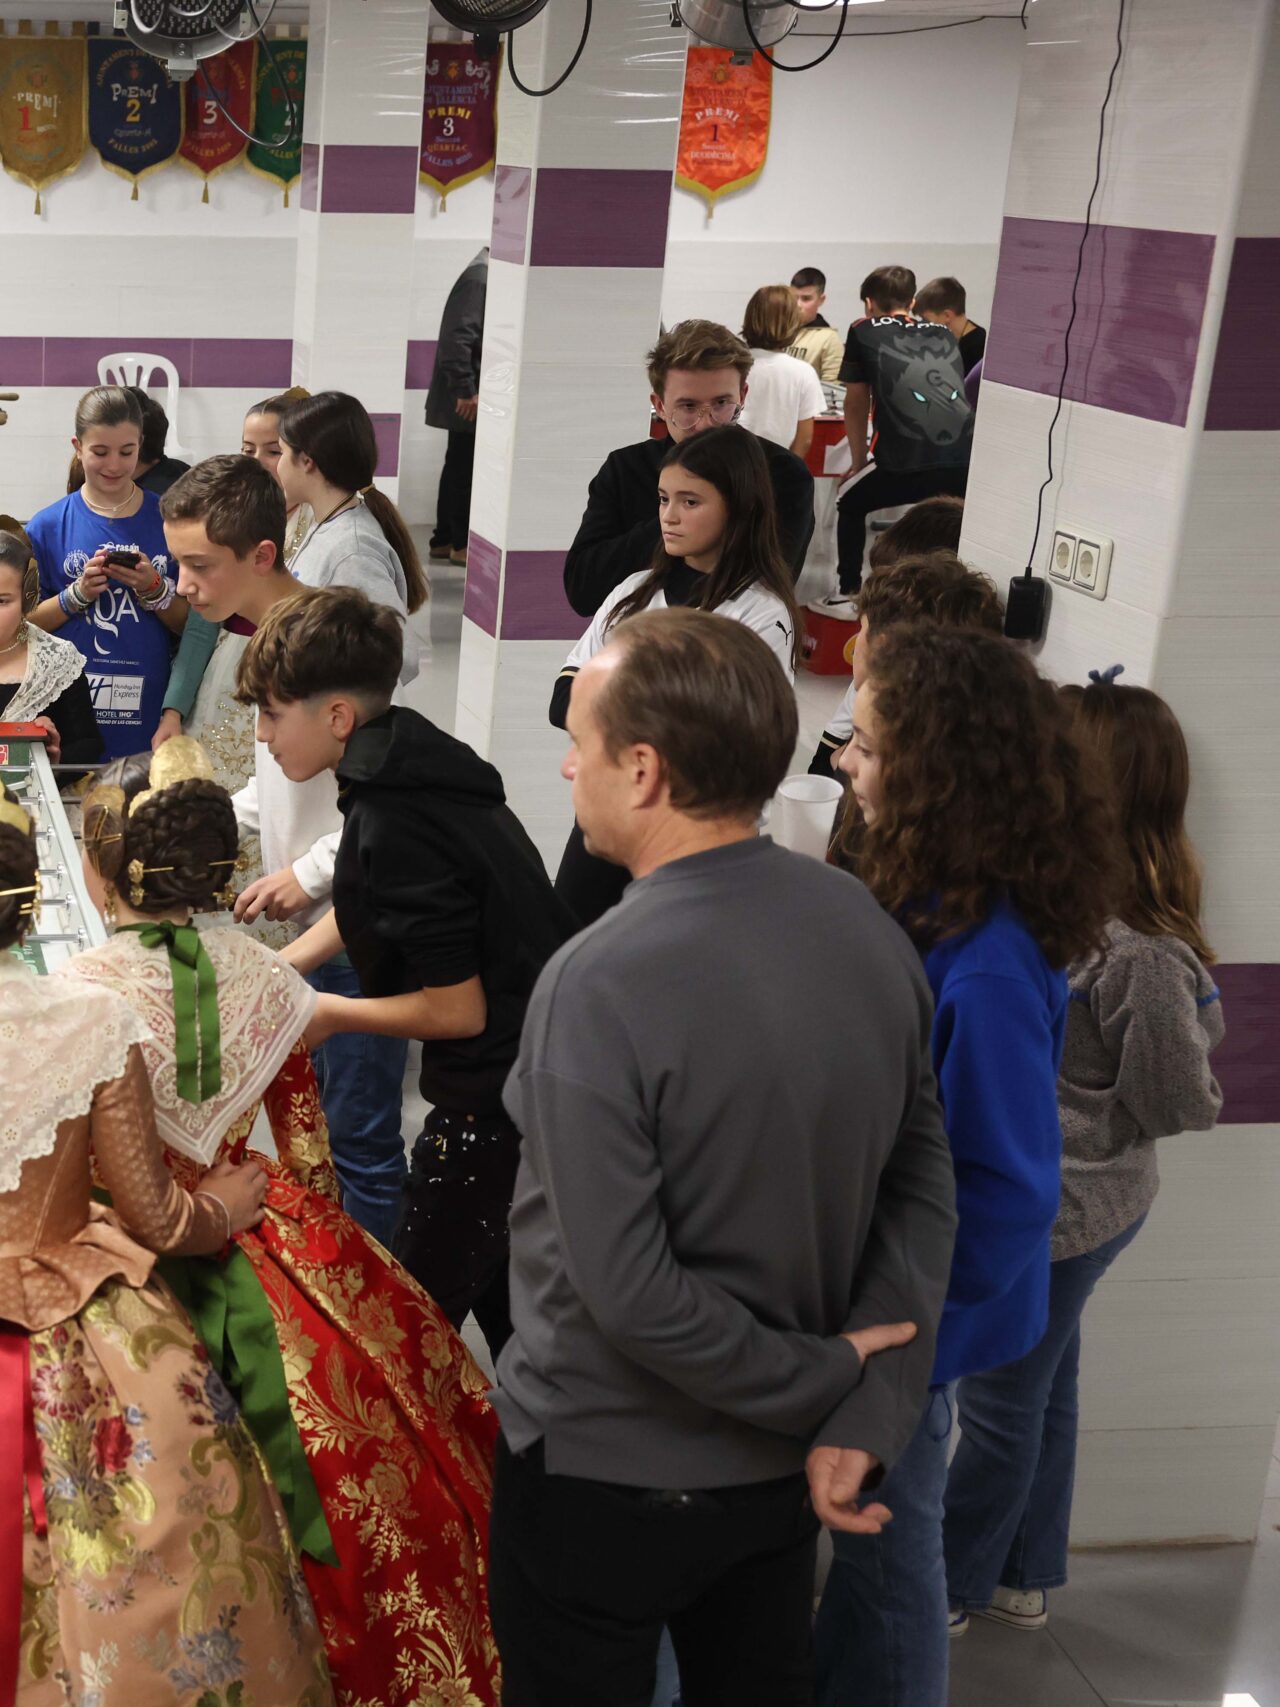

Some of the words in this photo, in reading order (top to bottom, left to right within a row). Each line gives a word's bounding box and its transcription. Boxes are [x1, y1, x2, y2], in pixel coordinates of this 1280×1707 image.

[111, 83, 158, 104] PREMI
[18, 106, 32, 131] 1
[126, 98, 141, 122] 2
[203, 100, 218, 124] 3
[427, 106, 472, 120] PREMI
[695, 106, 740, 122] PREMI
[442, 117, 454, 136] 3
[711, 123, 719, 142] 1
[113, 689, 139, 699] Express
